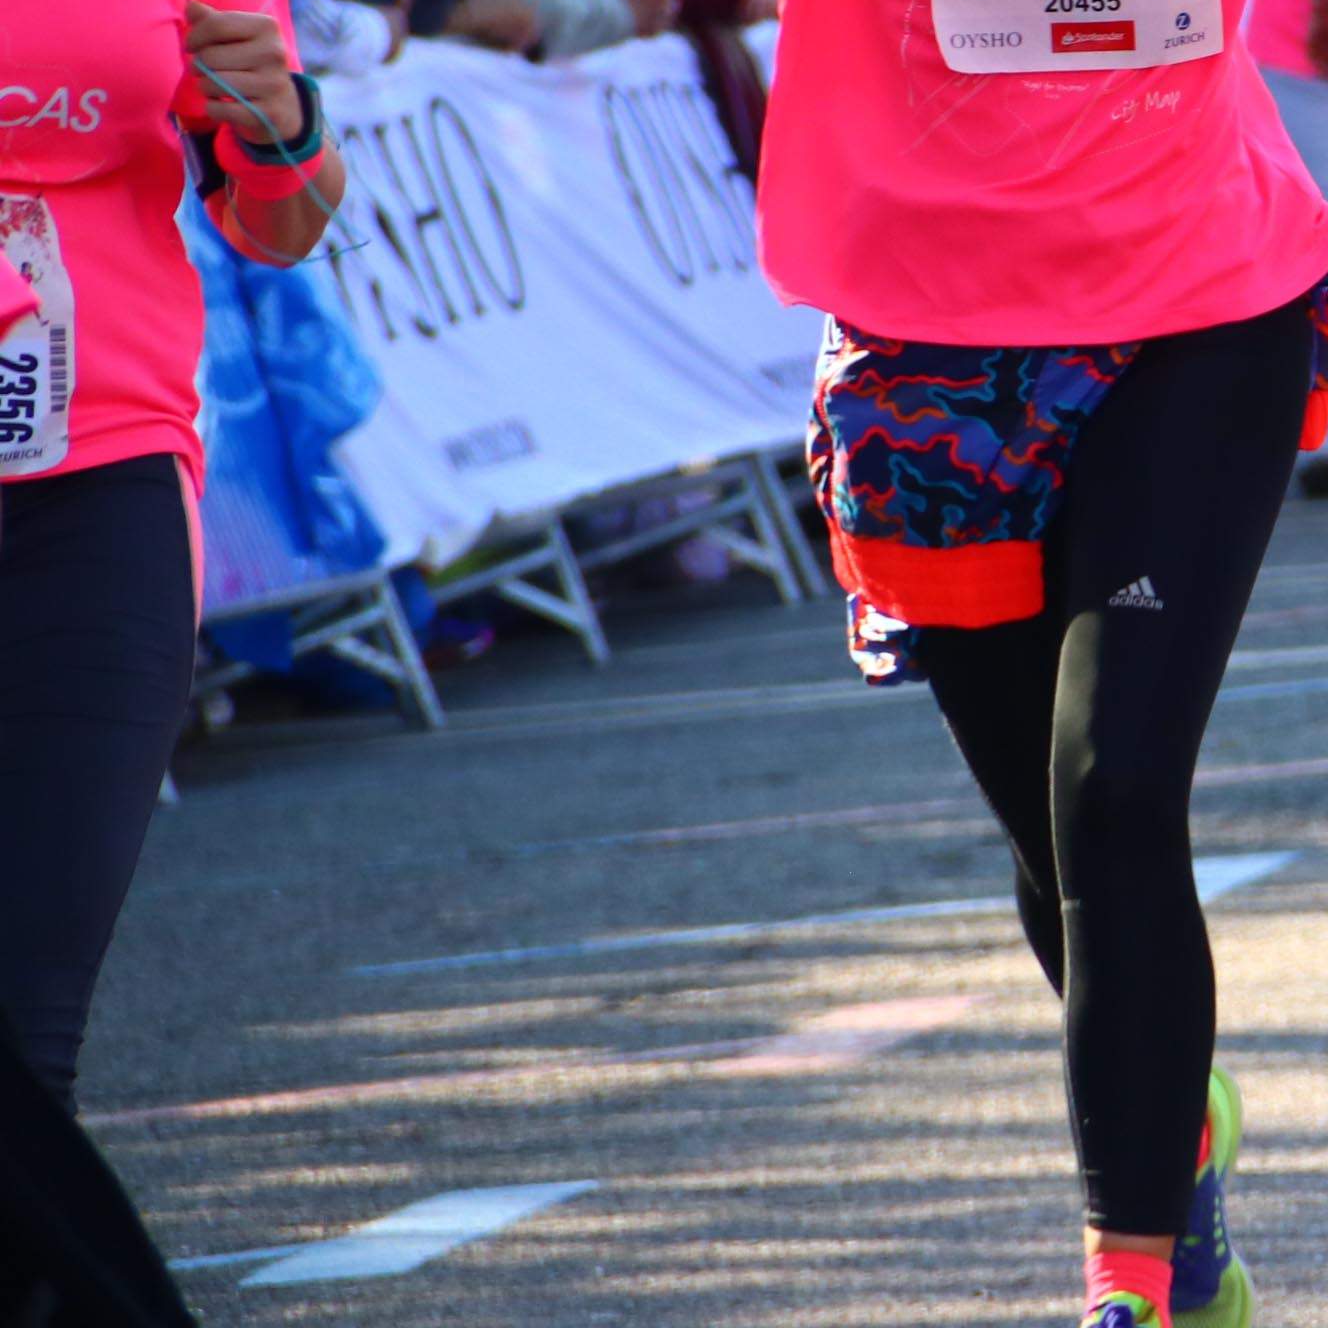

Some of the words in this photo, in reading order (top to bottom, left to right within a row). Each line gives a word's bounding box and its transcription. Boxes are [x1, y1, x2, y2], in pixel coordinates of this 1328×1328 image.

[950, 31, 1022, 49] OYSHO
[1164, 31, 1205, 49] ZURICH
[1108, 594, 1164, 610] adidas
